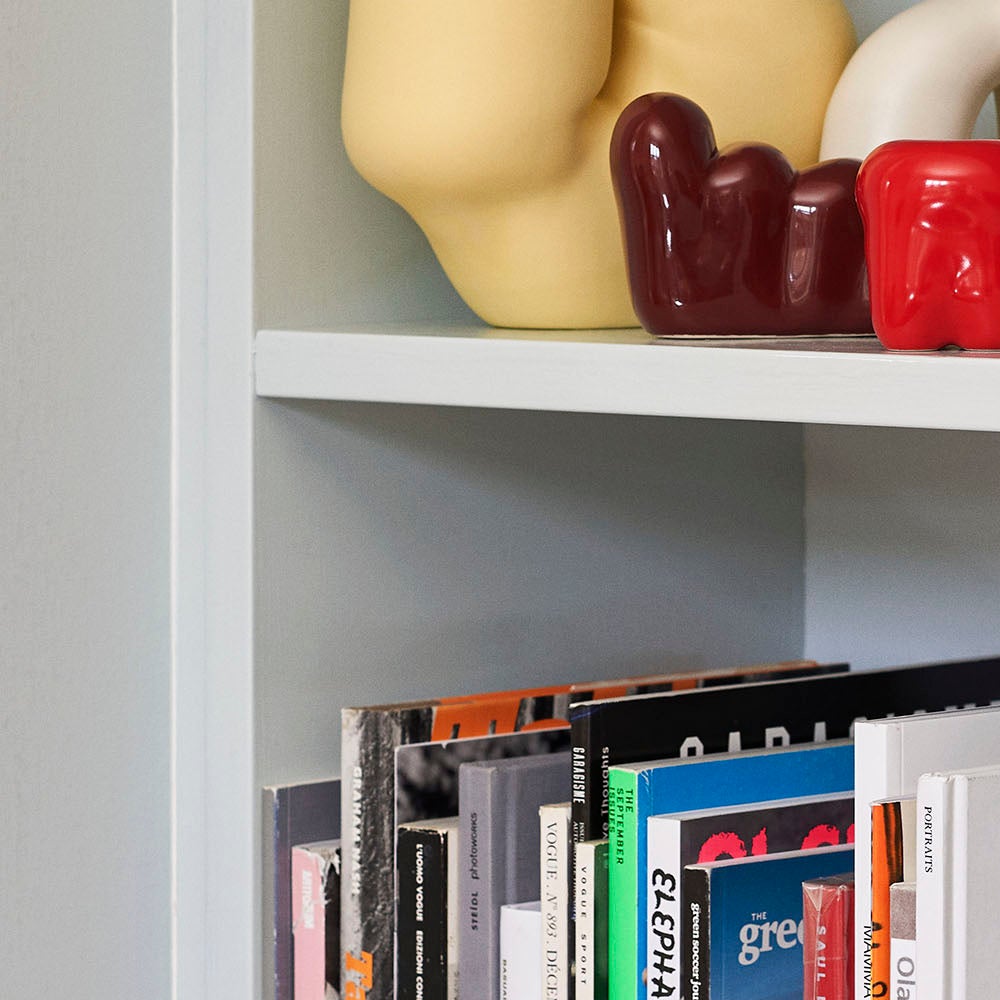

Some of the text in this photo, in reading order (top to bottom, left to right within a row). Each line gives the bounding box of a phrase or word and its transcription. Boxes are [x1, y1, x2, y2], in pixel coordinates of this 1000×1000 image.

[573, 747, 586, 805] GARAGISME
[353, 767, 362, 842] GRAHAM
[626, 788, 634, 814] THE
[546, 822, 559, 881] VOGUE
[925, 806, 933, 873] PORTRAITS
[415, 843, 424, 884] L'UOMO
[415, 887, 424, 922] VOGUE
[690, 902, 702, 938] green
[751, 911, 768, 921] THE
[546, 914, 559, 939] 893
[738, 918, 804, 966] gre
[415, 931, 424, 975] EDIZIONI
[690, 940, 702, 979] soccer
[816, 926, 827, 982] SAUL
